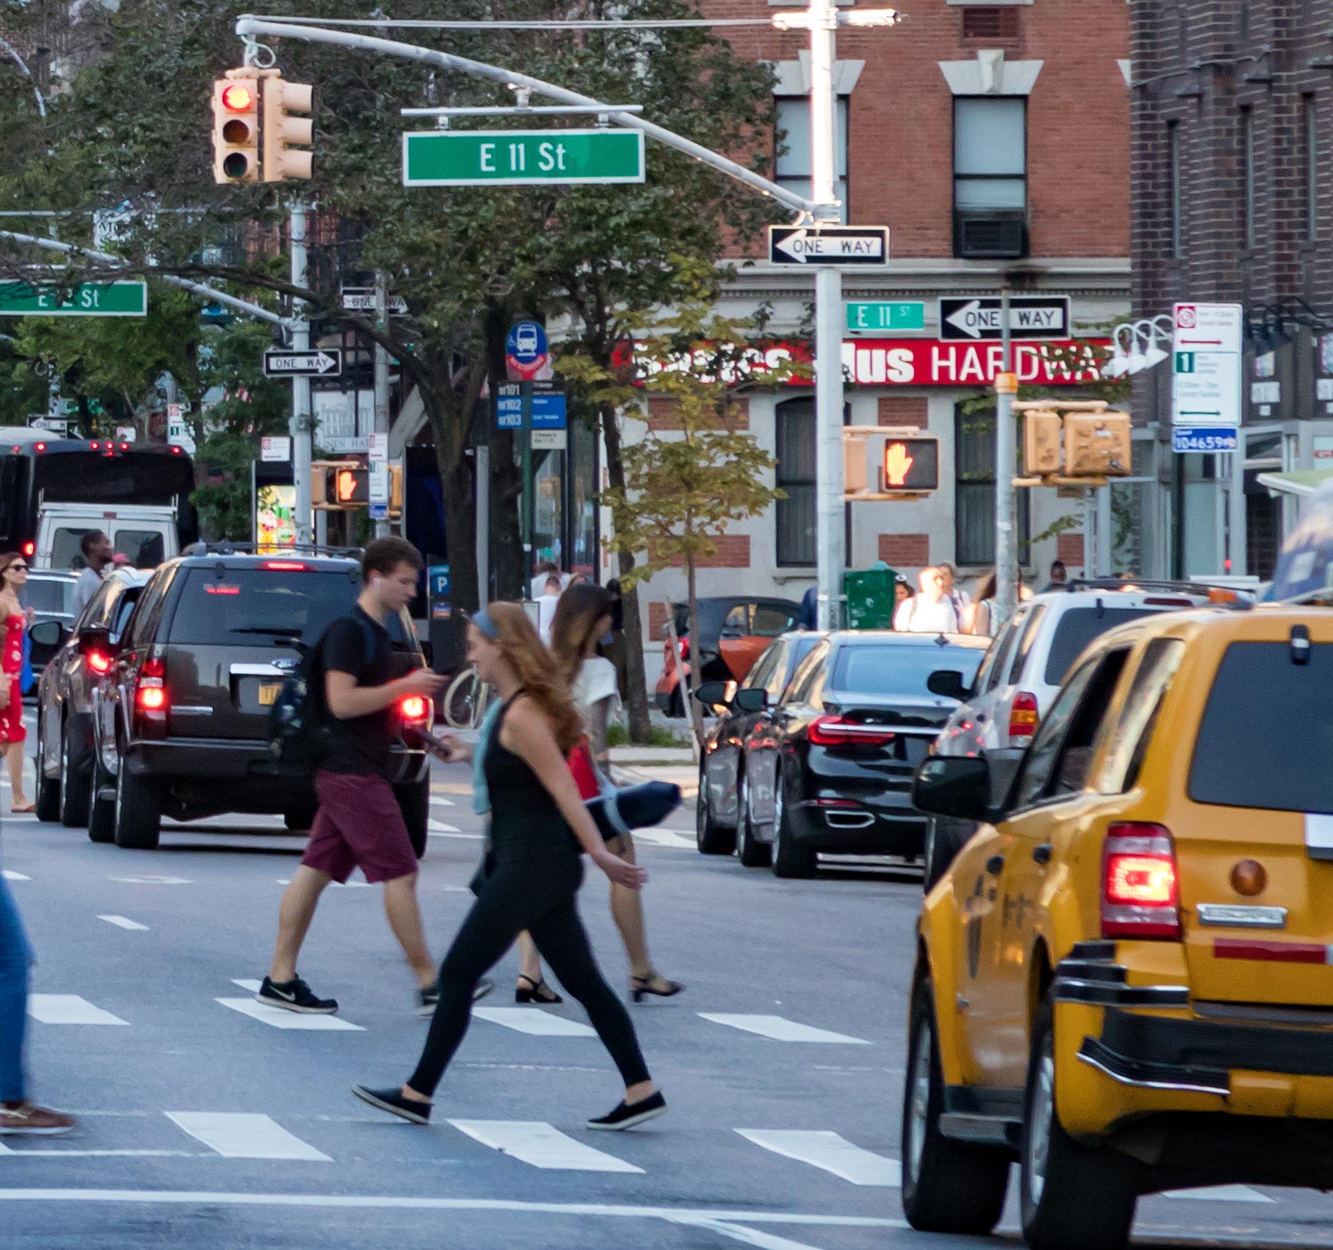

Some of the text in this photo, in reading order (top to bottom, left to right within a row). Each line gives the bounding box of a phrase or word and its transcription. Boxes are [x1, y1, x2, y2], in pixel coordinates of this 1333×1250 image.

[480, 142, 566, 171] E 11 St
[793, 240, 874, 254] ONE WAY
[81, 289, 100, 308] St
[857, 306, 869, 327] E
[878, 306, 891, 327] 11
[965, 311, 1056, 327] ONE WAY
[275, 359, 330, 369] ONE WAY
[812, 342, 915, 383] lus
[1181, 352, 1190, 372] 1
[437, 576, 448, 593] P
